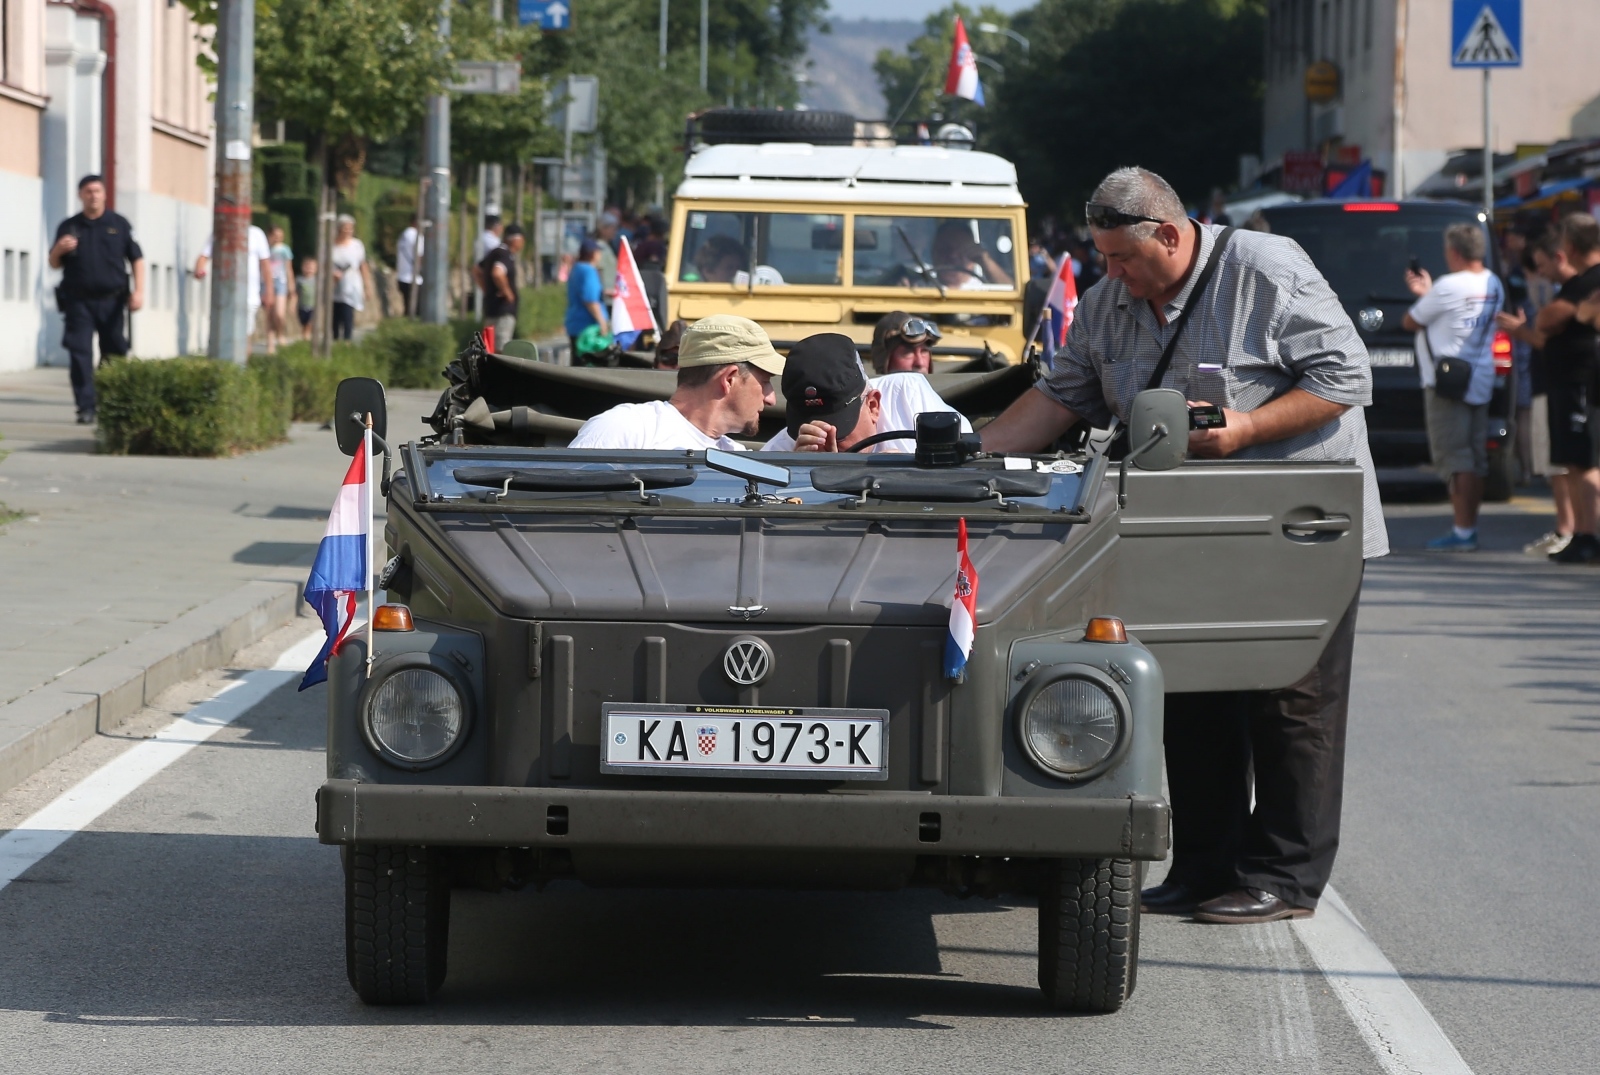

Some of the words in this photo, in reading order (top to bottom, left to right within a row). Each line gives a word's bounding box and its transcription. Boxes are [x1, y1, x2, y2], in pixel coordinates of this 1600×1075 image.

[724, 640, 769, 685] VW
[638, 719, 690, 761] KA
[732, 721, 872, 765] 1973-K
